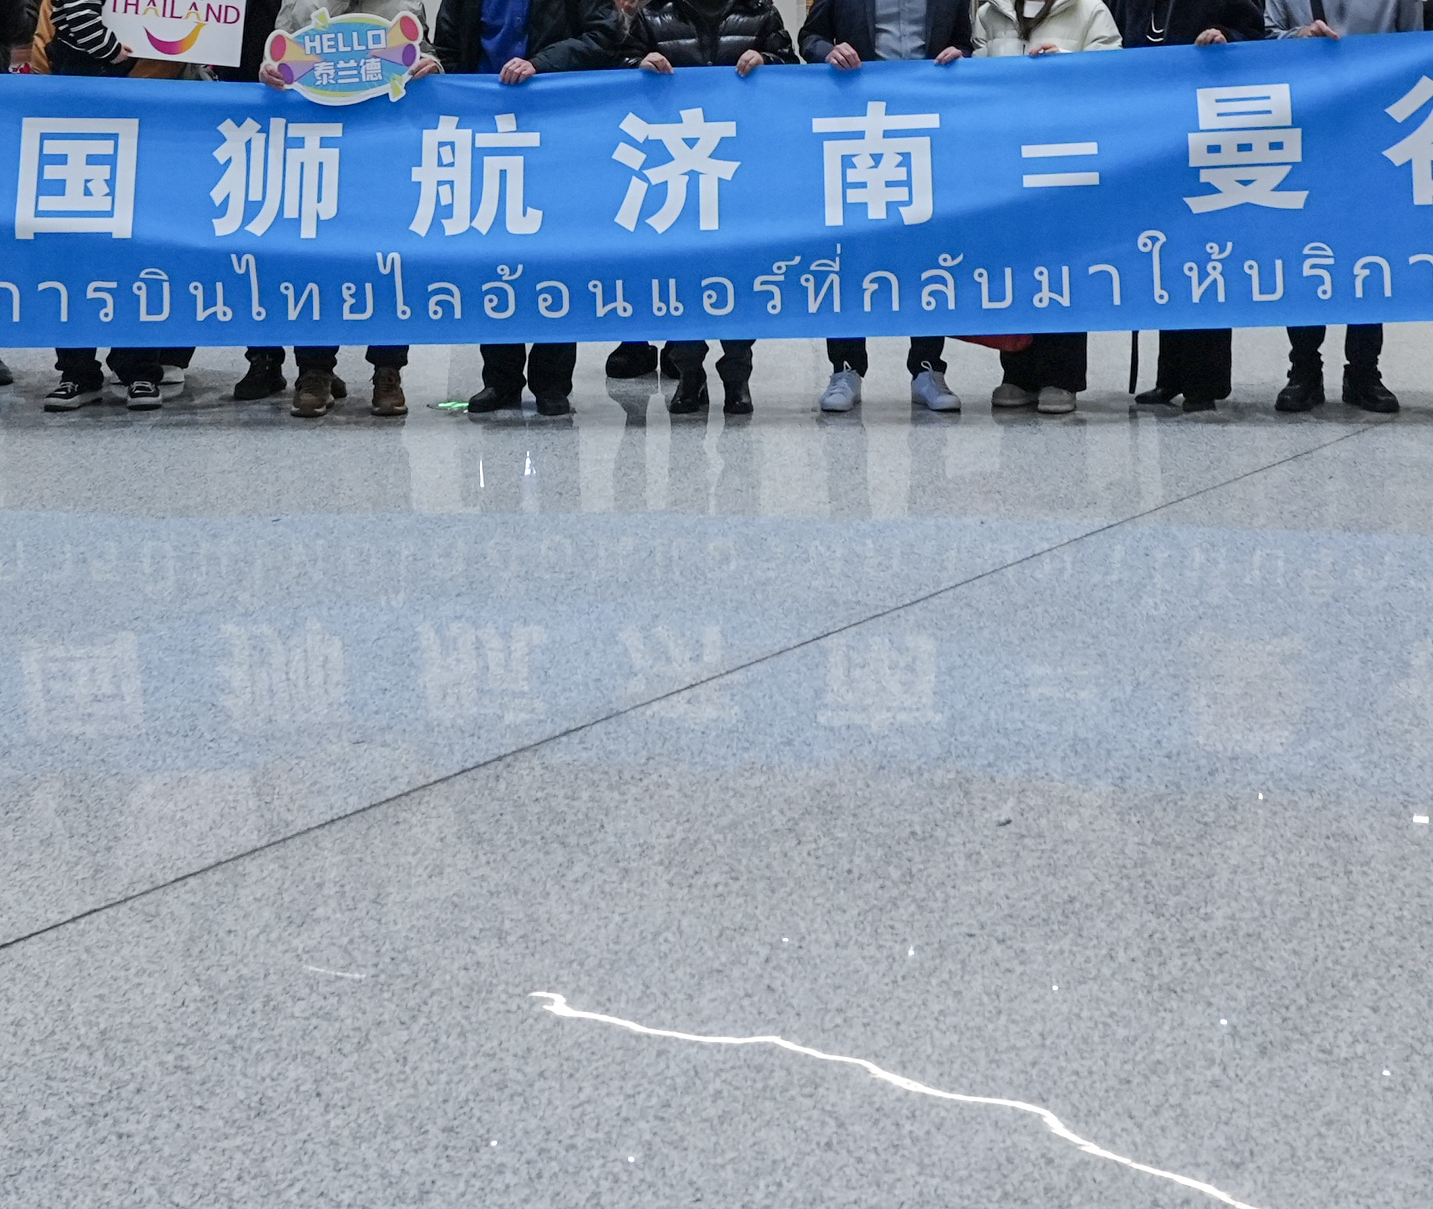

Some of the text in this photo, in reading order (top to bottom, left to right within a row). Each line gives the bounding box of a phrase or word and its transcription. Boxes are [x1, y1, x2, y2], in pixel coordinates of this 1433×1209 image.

[303, 29, 388, 55] HELLO
[313, 58, 383, 86] 泰兰德
